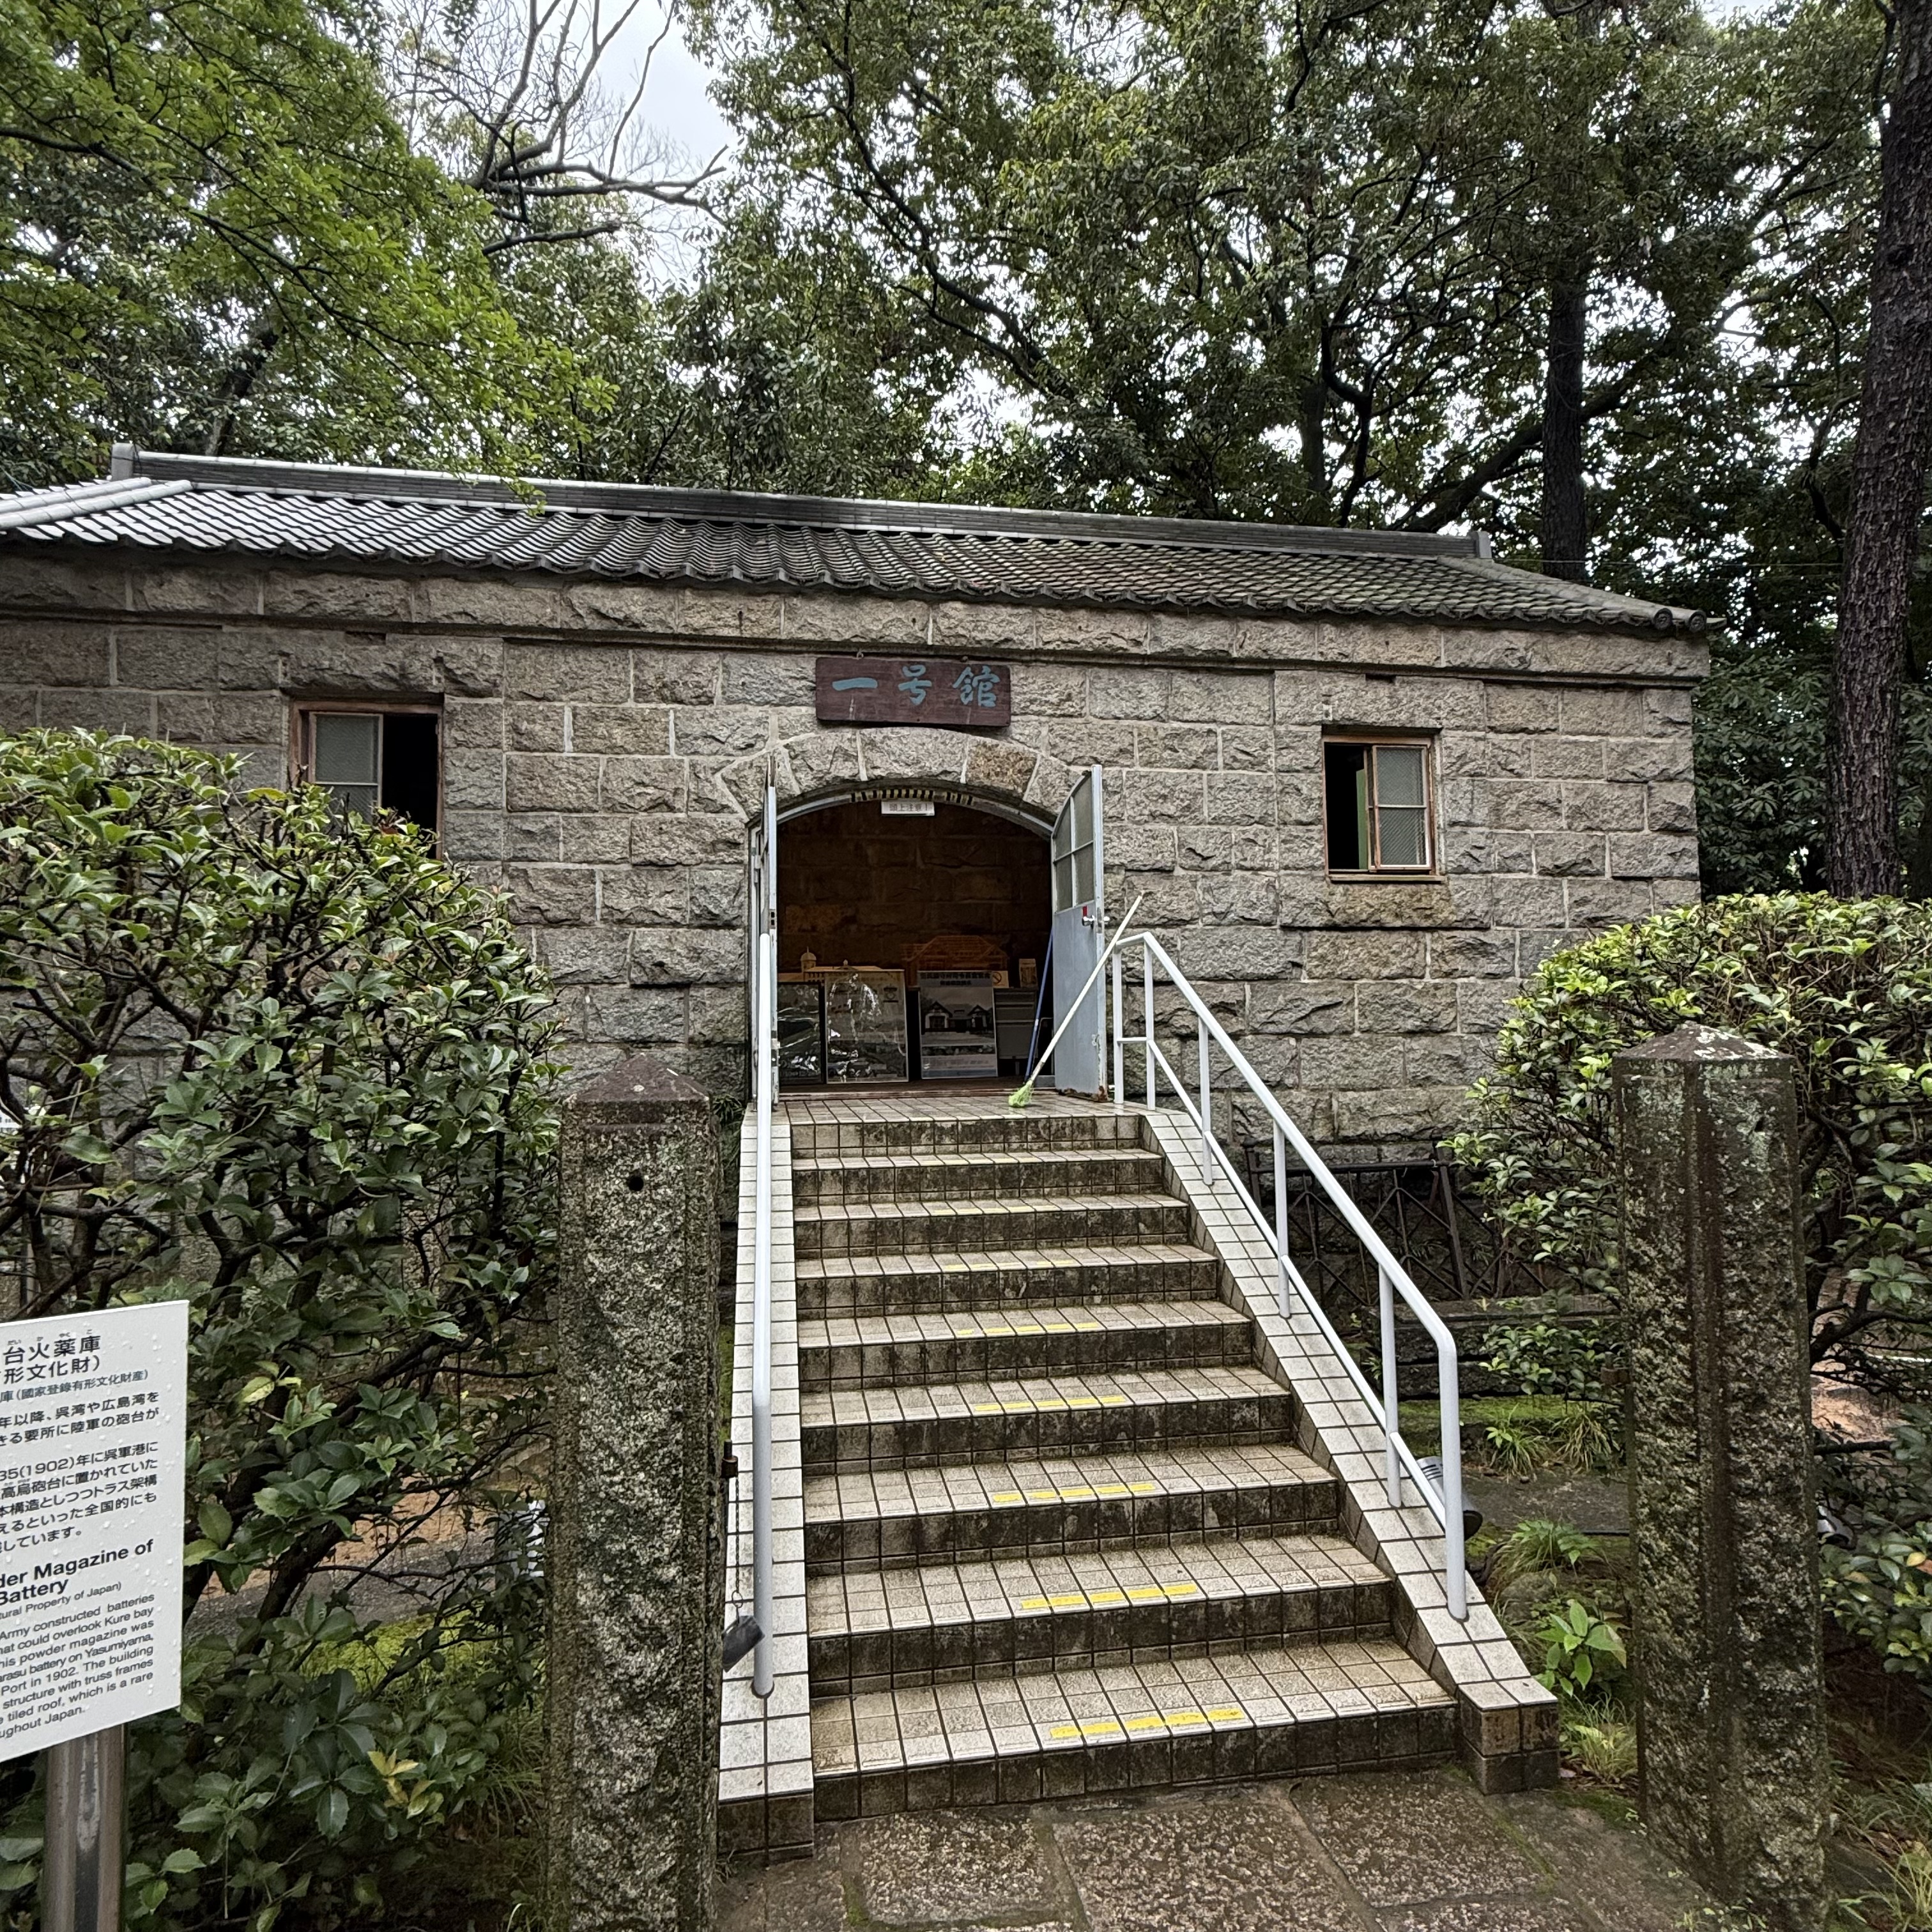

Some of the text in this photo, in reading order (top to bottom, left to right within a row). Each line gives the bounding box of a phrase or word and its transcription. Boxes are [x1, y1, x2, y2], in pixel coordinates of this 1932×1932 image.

[832, 664, 1000, 708] 一号館
[3, 1335, 101, 1365] 台火薬庫
[0, 1526, 82, 1553] しています。
[34, 1547, 128, 1580] Magazine
[135, 1538, 153, 1555] of
[0, 1594, 155, 1641] Army constructed batteries
[26, 1595, 71, 1613] Property
[74, 1590, 84, 1600] of
[87, 1581, 121, 1597] Japan)
[17, 1633, 49, 1650] could
[53, 1620, 102, 1640] overlook
[104, 1613, 131, 1627] Kure
[134, 1607, 154, 1618] bay
[20, 1644, 66, 1666] powder
[70, 1627, 127, 1649] magazine
[131, 1620, 154, 1632] was
[1, 1646, 153, 1696] Port in 1902. The building
[3, 1659, 153, 1709] structure with truss frames
[29, 1657, 67, 1675] battery
[68, 1653, 82, 1662] on
[8, 1706, 34, 1722] tiled
[38, 1697, 65, 1713] roof,
[69, 1685, 103, 1703] which
[107, 1682, 116, 1692] is
[119, 1680, 126, 1688] a
[130, 1671, 153, 1685] rare
[45, 1707, 86, 1724] Japan.
